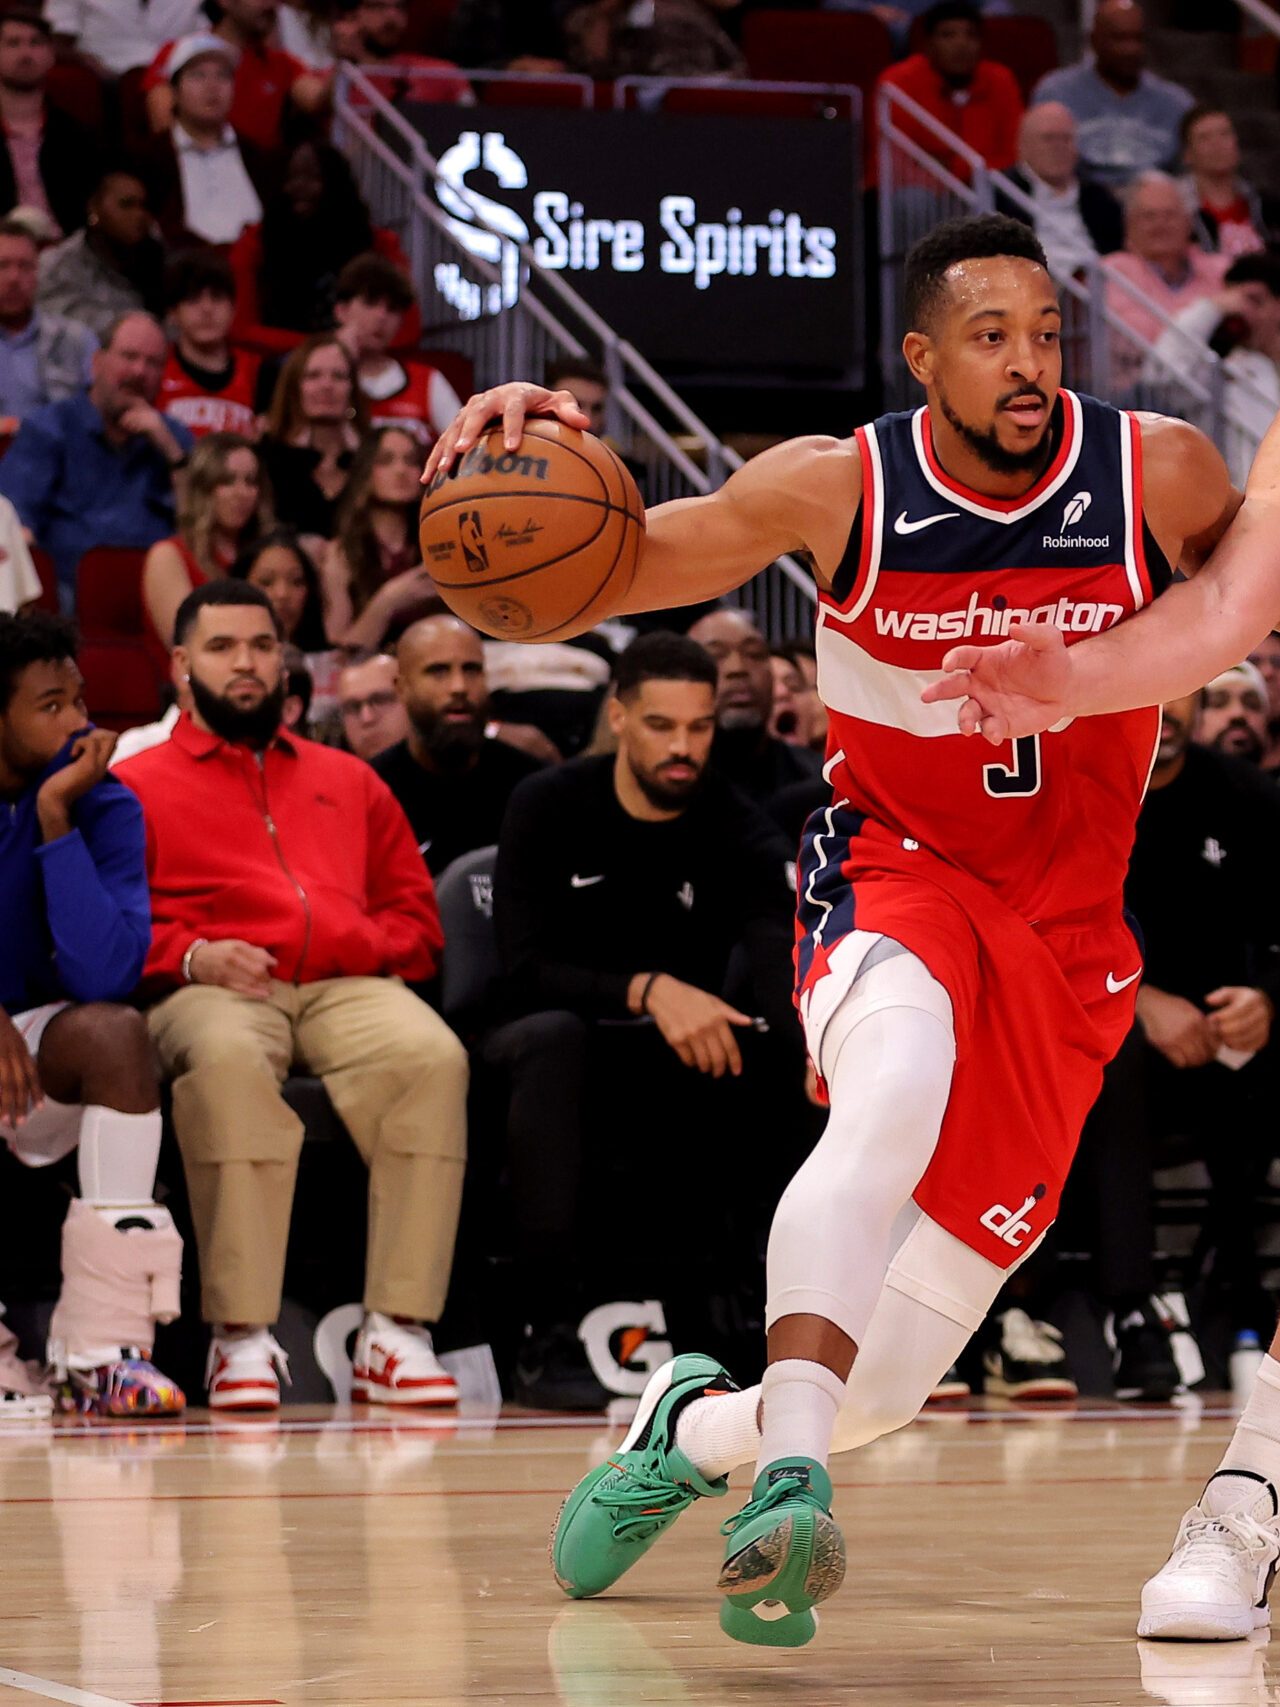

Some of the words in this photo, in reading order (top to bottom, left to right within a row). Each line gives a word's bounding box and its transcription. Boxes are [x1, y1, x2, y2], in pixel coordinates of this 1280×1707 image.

[533, 190, 646, 272] Sire
[659, 195, 837, 290] Spirits
[1042, 535, 1110, 548] Robinhood
